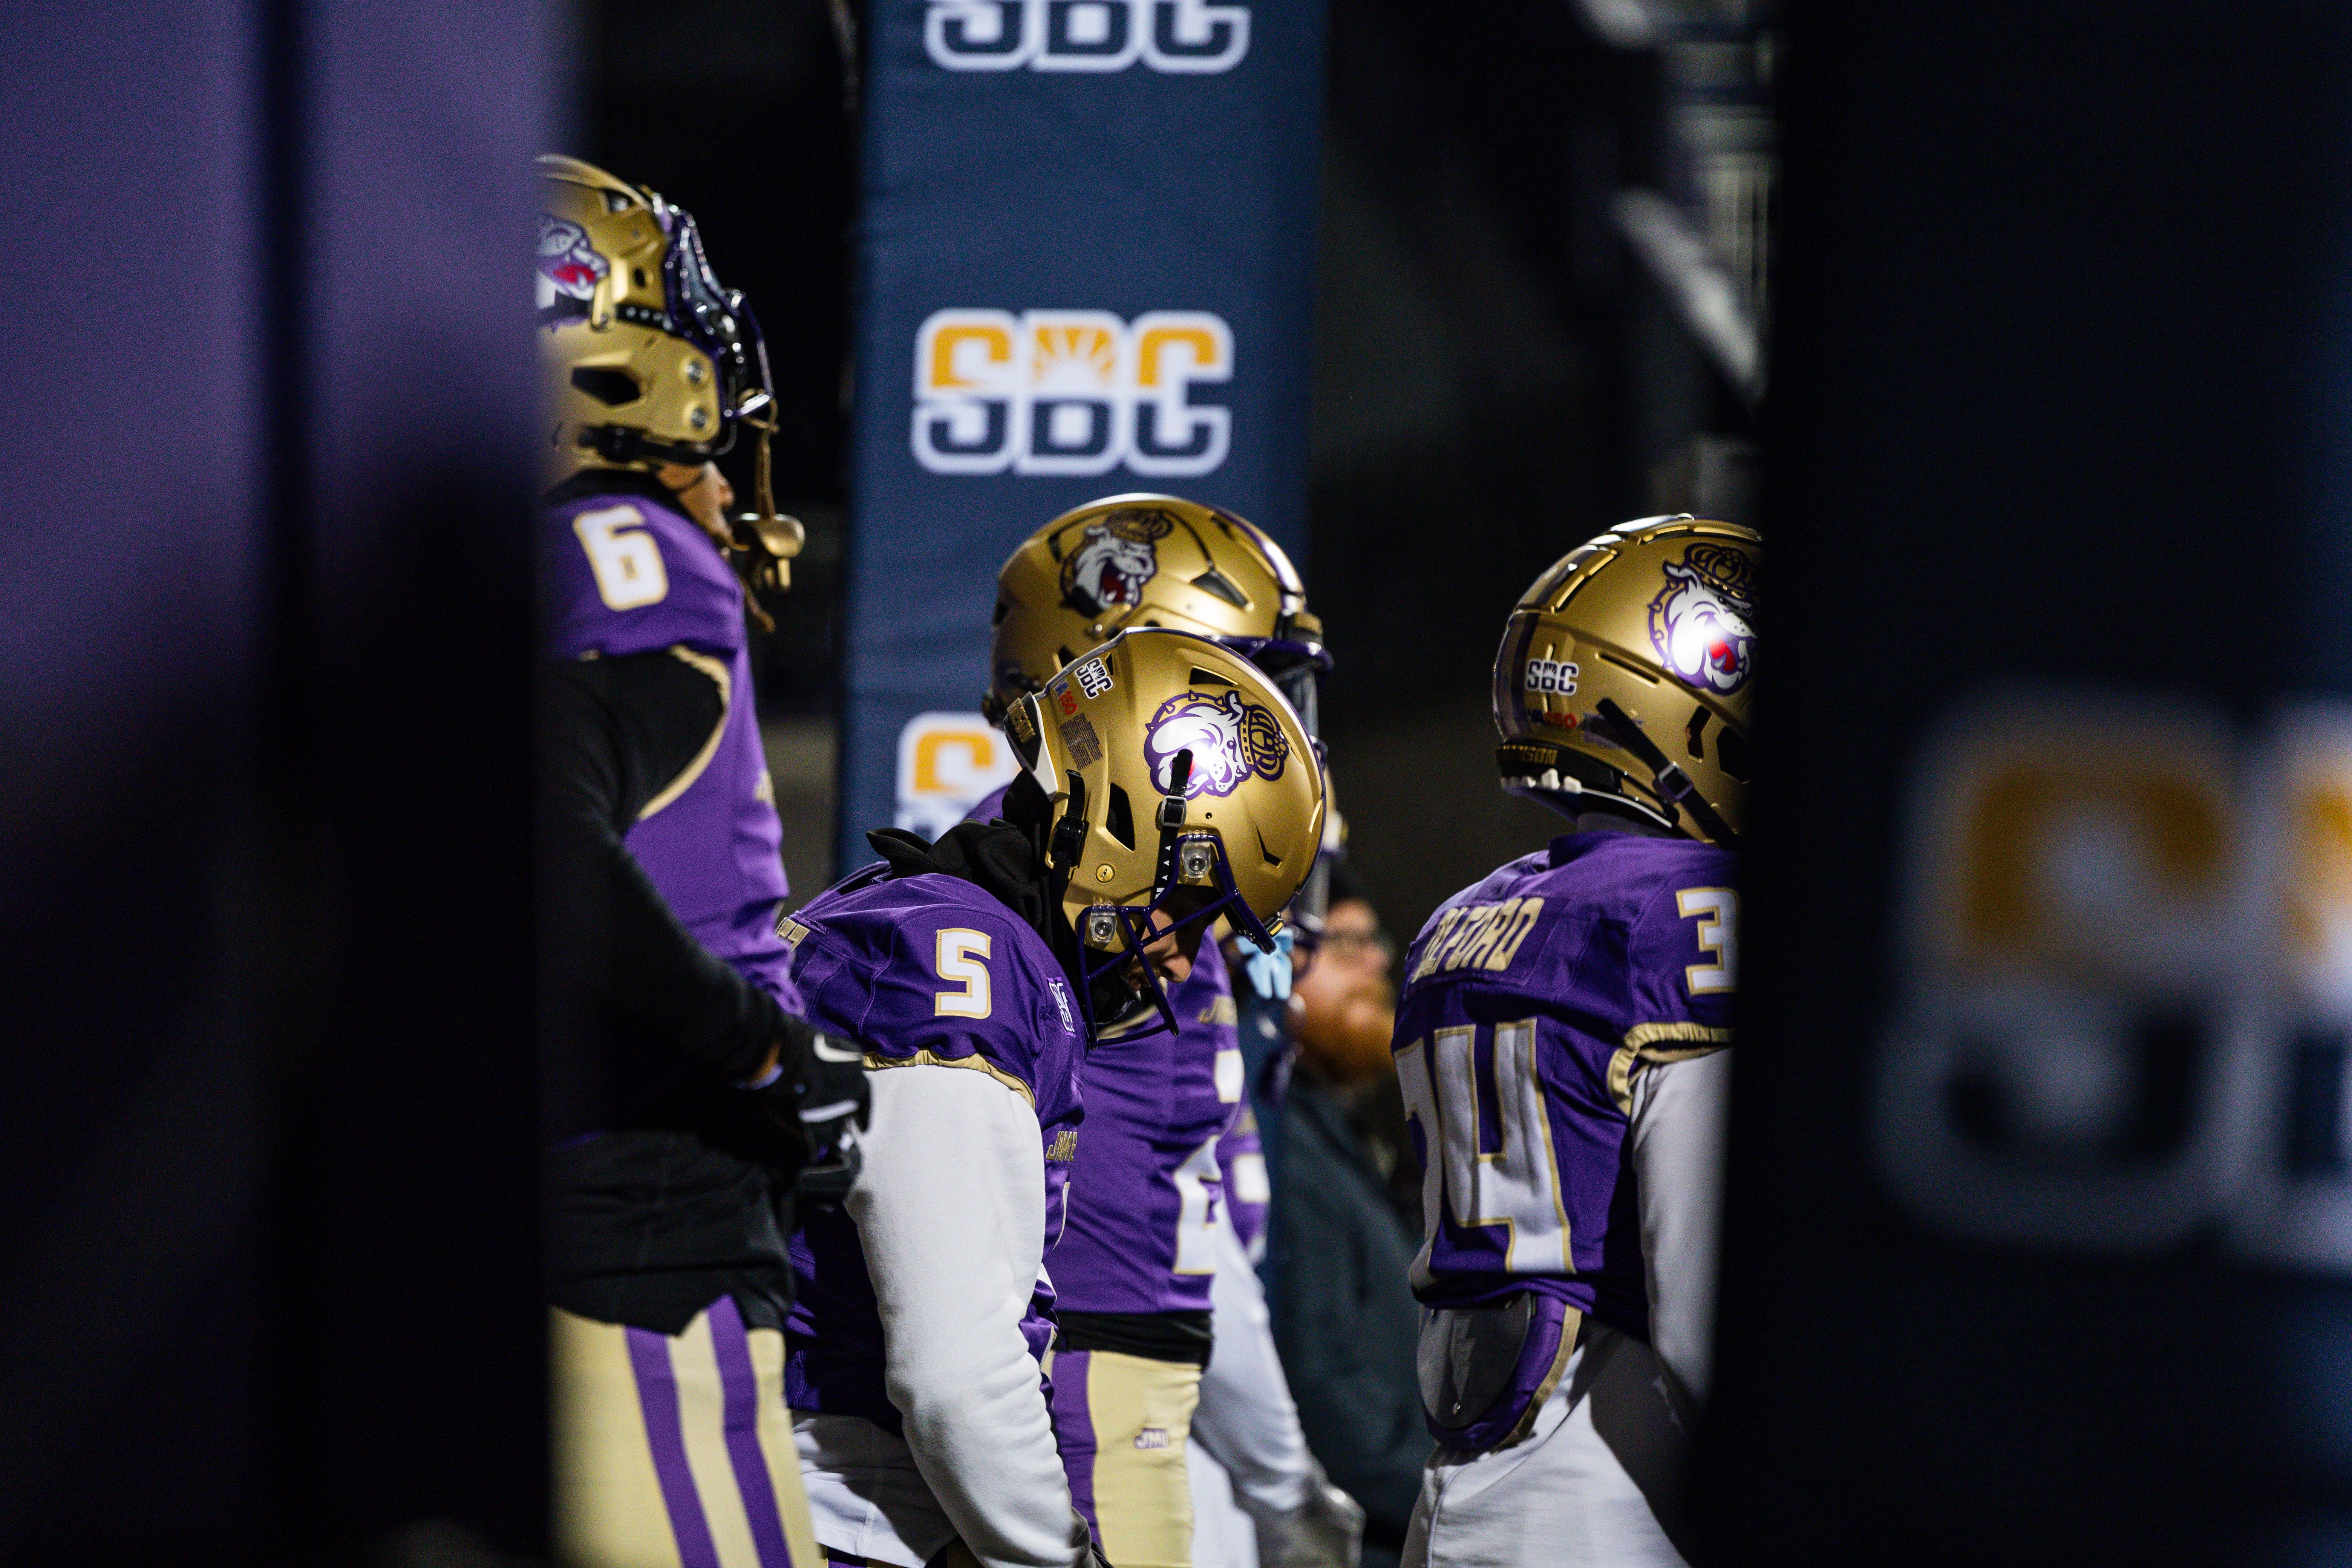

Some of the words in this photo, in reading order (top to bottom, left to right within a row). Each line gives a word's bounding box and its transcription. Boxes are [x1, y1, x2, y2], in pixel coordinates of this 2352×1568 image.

[911, 307, 1236, 478] SBC
[573, 505, 668, 612] 6
[1075, 658, 1113, 699] SBC
[1525, 658, 1579, 695] SBC
[935, 928, 991, 1020] 5
